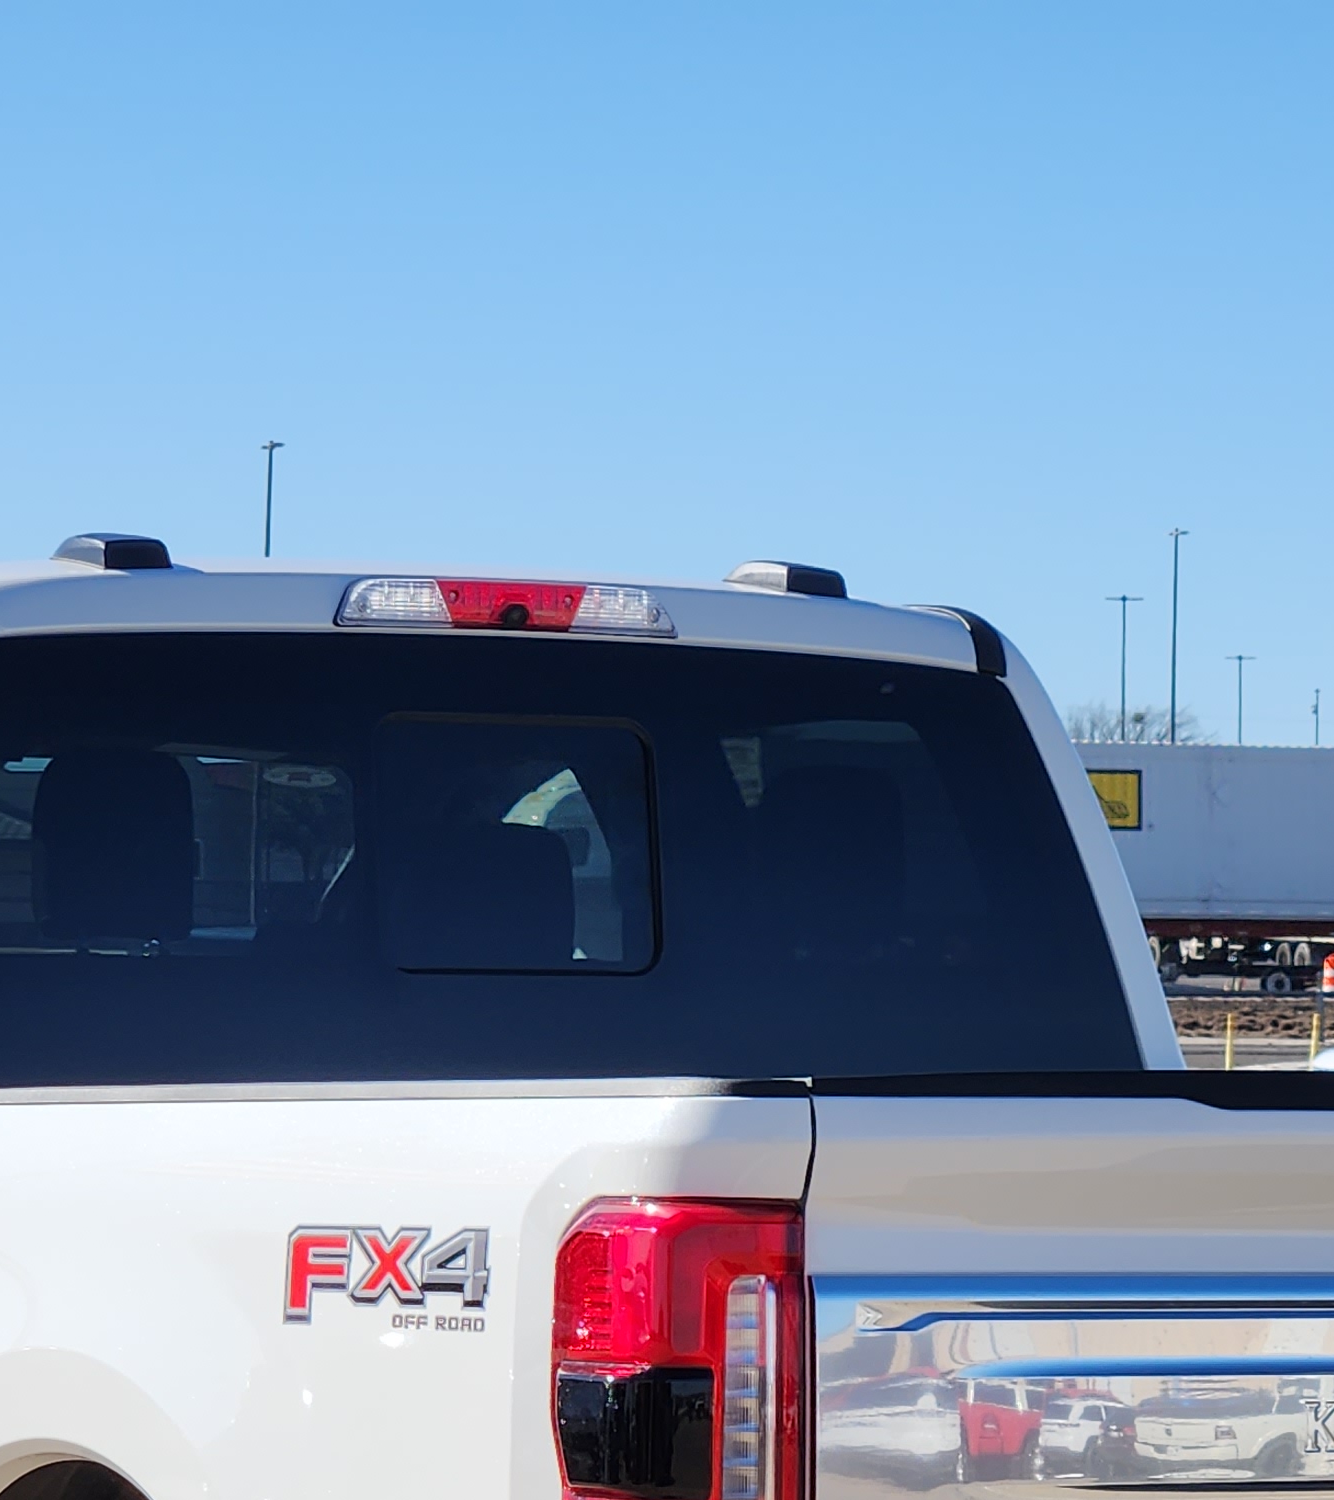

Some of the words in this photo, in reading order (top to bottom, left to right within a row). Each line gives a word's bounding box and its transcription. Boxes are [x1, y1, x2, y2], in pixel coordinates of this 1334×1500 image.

[283, 1226, 490, 1324] FX4
[392, 1314, 428, 1330] OFF
[435, 1316, 485, 1332] ROAD
